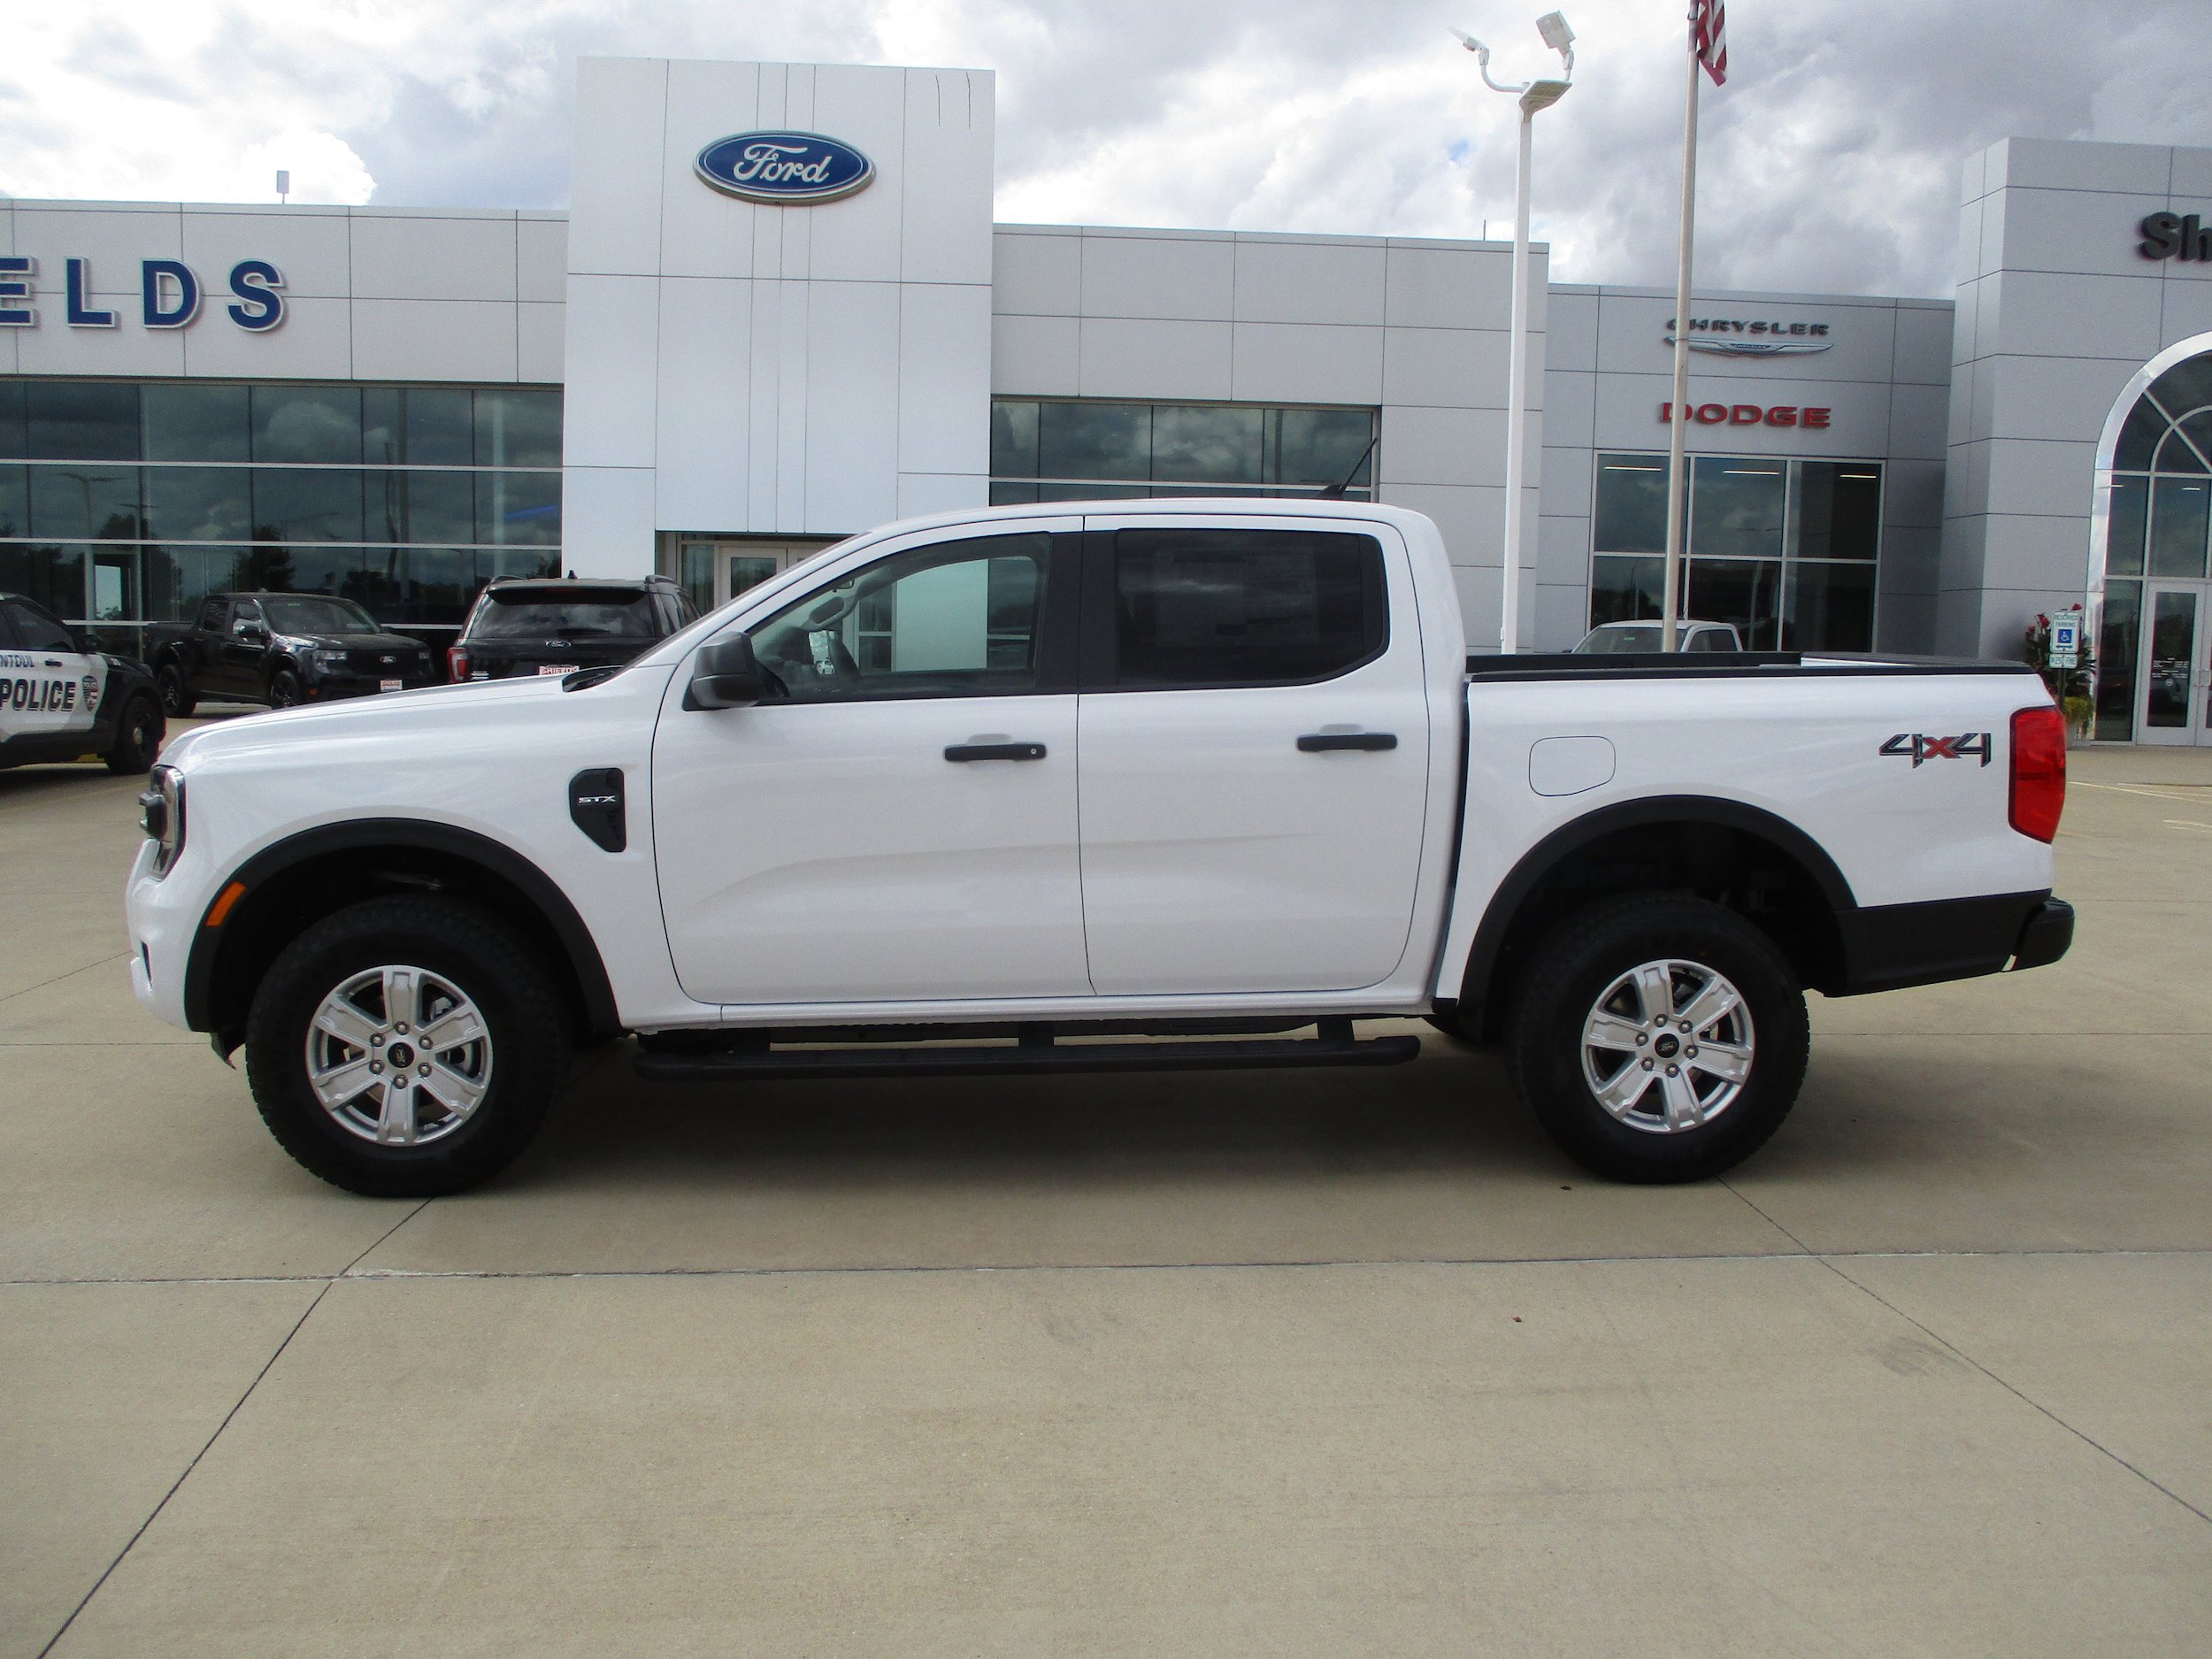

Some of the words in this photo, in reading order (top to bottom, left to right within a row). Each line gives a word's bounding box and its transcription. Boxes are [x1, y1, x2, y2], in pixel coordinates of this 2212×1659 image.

[733, 143, 833, 183] Ford
[2138, 211, 2212, 261] Sh
[0, 257, 284, 332] ELDS
[1663, 402, 1832, 428] DODGE
[0, 679, 76, 711] POLICE
